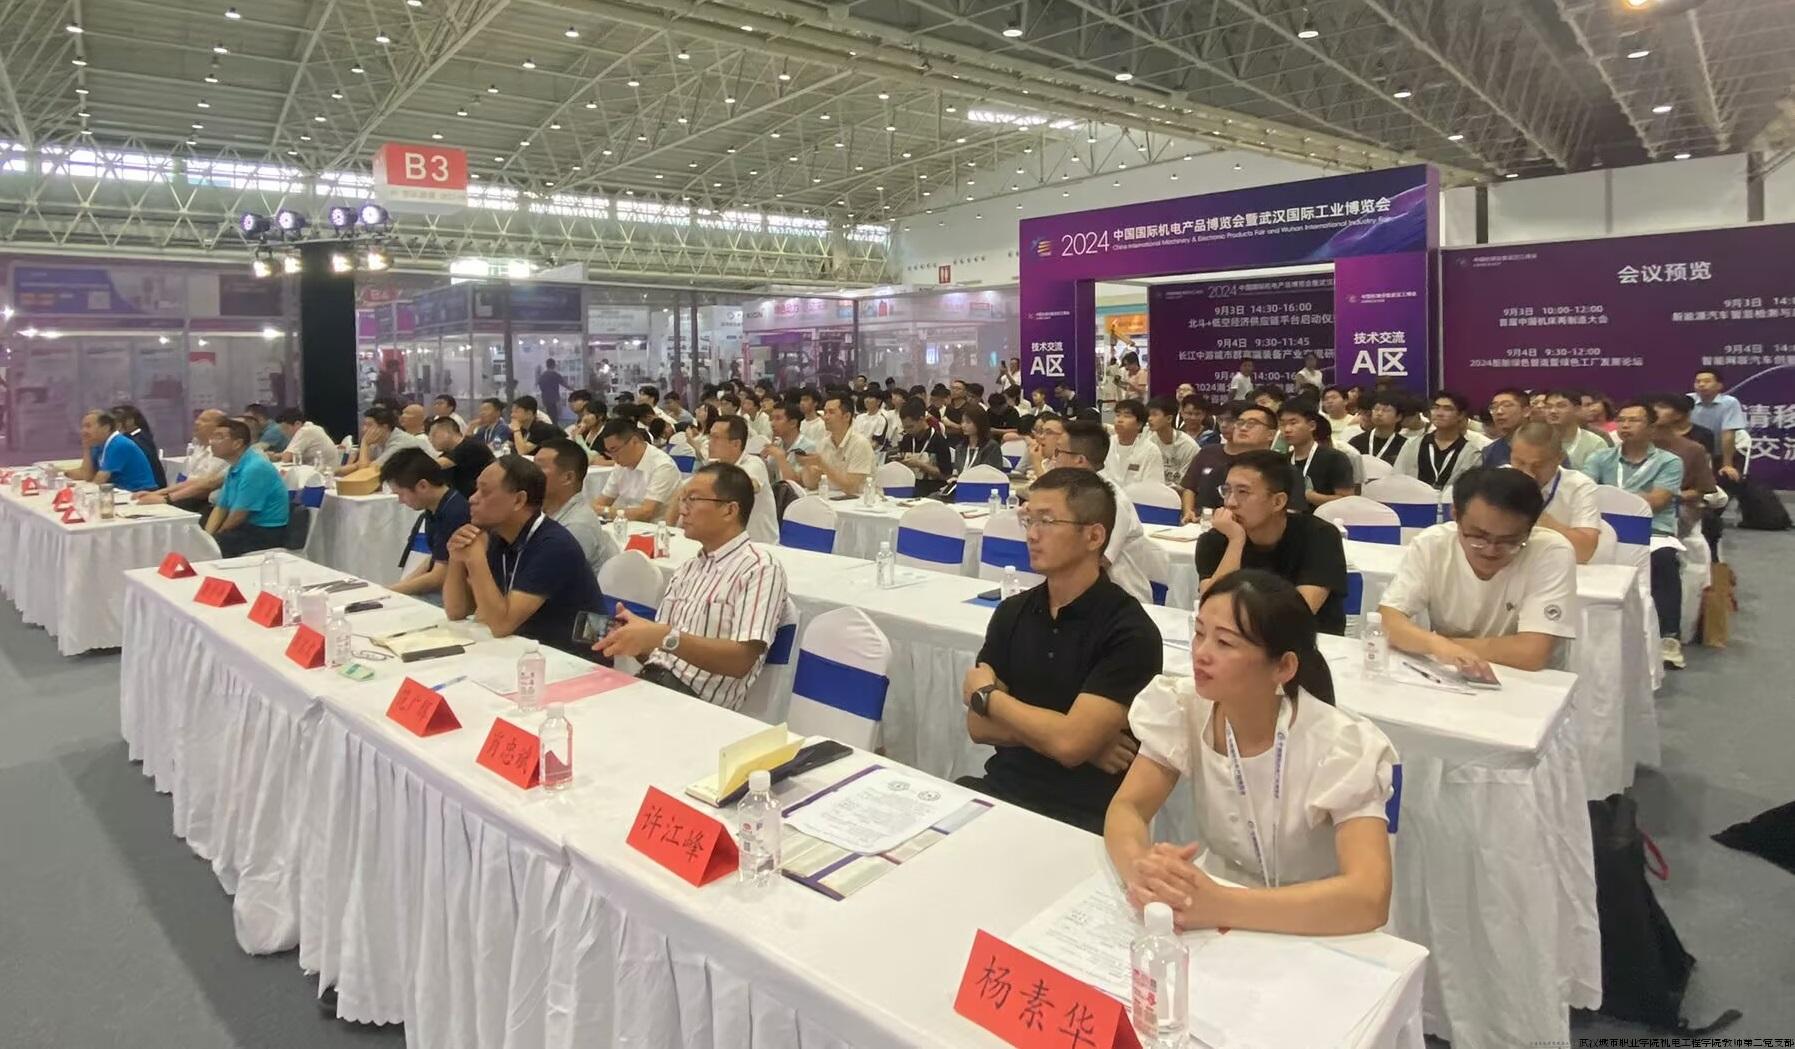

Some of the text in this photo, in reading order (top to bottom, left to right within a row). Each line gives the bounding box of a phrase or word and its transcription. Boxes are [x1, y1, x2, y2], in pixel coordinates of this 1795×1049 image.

[405, 152, 449, 182] B3
[1061, 197, 1391, 257] 2024 中国国际机电产品博览会暨武汉国际工业博览会
[1281, 225, 1303, 233] Wuhan
[1305, 220, 1347, 230] International
[1617, 261, 1712, 284] 会议预览
[1215, 302, 1312, 316] 9月3日 14:30-16:00
[1723, 298, 1762, 308] 9月3日
[1503, 305, 1603, 317] 9月3日 10:00-12:00
[1188, 314, 1334, 328] 北斗+低空经济供应链平台启动仪
[1217, 337, 1310, 348] 9月4日 9:30-11:45
[1354, 331, 1406, 344] 技术交流
[1031, 341, 1063, 352] 技术交流
[1506, 347, 1601, 357] 9月4日 9:30-12:00
[1723, 344, 1762, 353] 9月4日
[1030, 354, 1065, 377] A区
[1351, 347, 1408, 376] A区
[640, 804, 704, 863] 许江峰
[976, 955, 1097, 1049] 杨素华
